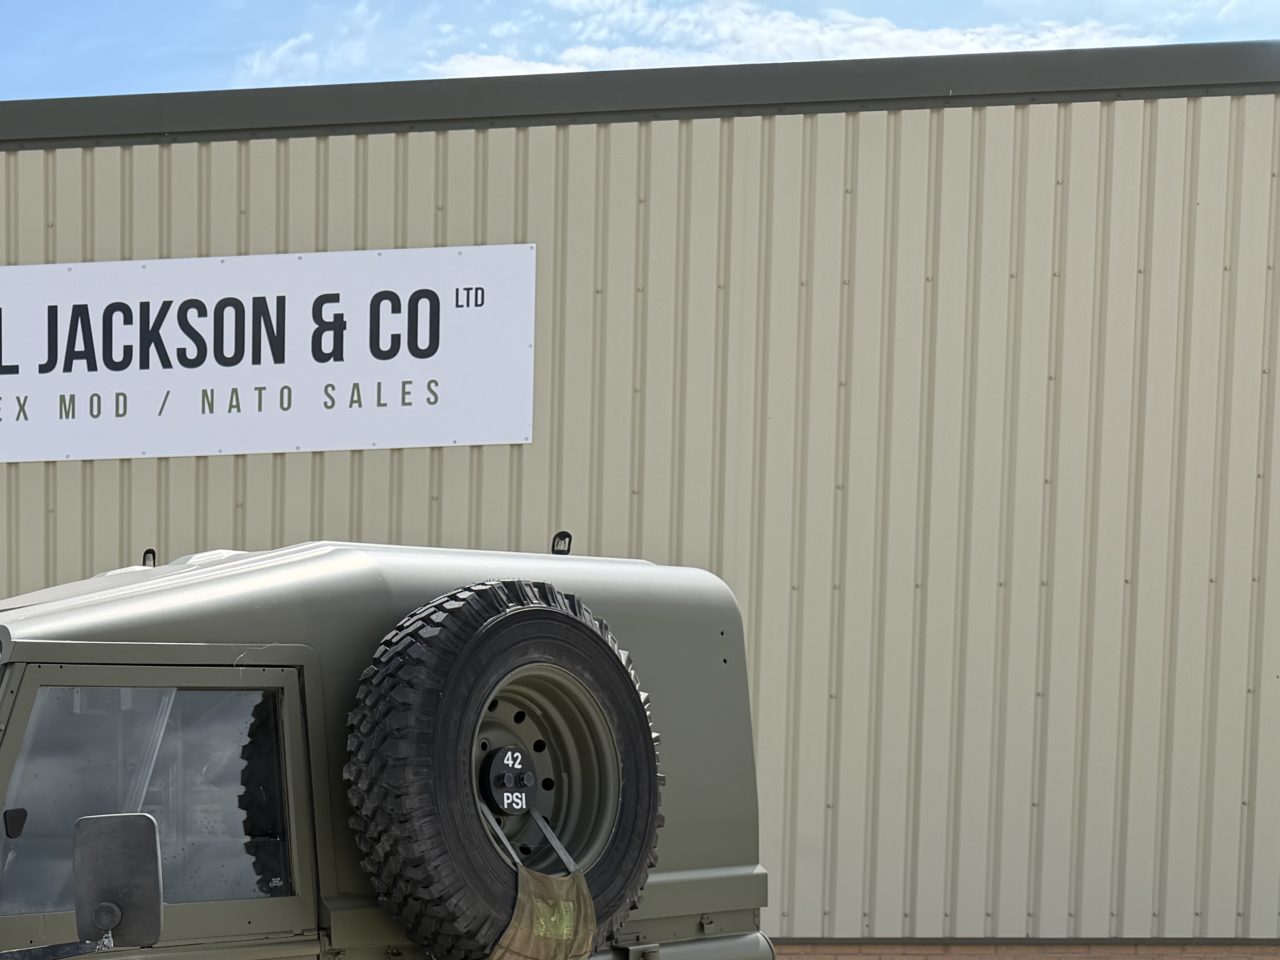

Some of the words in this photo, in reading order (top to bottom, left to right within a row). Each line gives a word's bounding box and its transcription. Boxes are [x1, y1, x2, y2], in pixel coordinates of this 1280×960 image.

[38, 294, 287, 375] JACKSON
[310, 292, 347, 364] &
[368, 288, 441, 361] CO
[454, 286, 486, 309] LTD
[58, 391, 129, 421] MOD
[201, 385, 293, 415] NATO
[323, 379, 440, 410] SALES
[503, 750, 523, 770] 42
[503, 792, 527, 810] PSI
